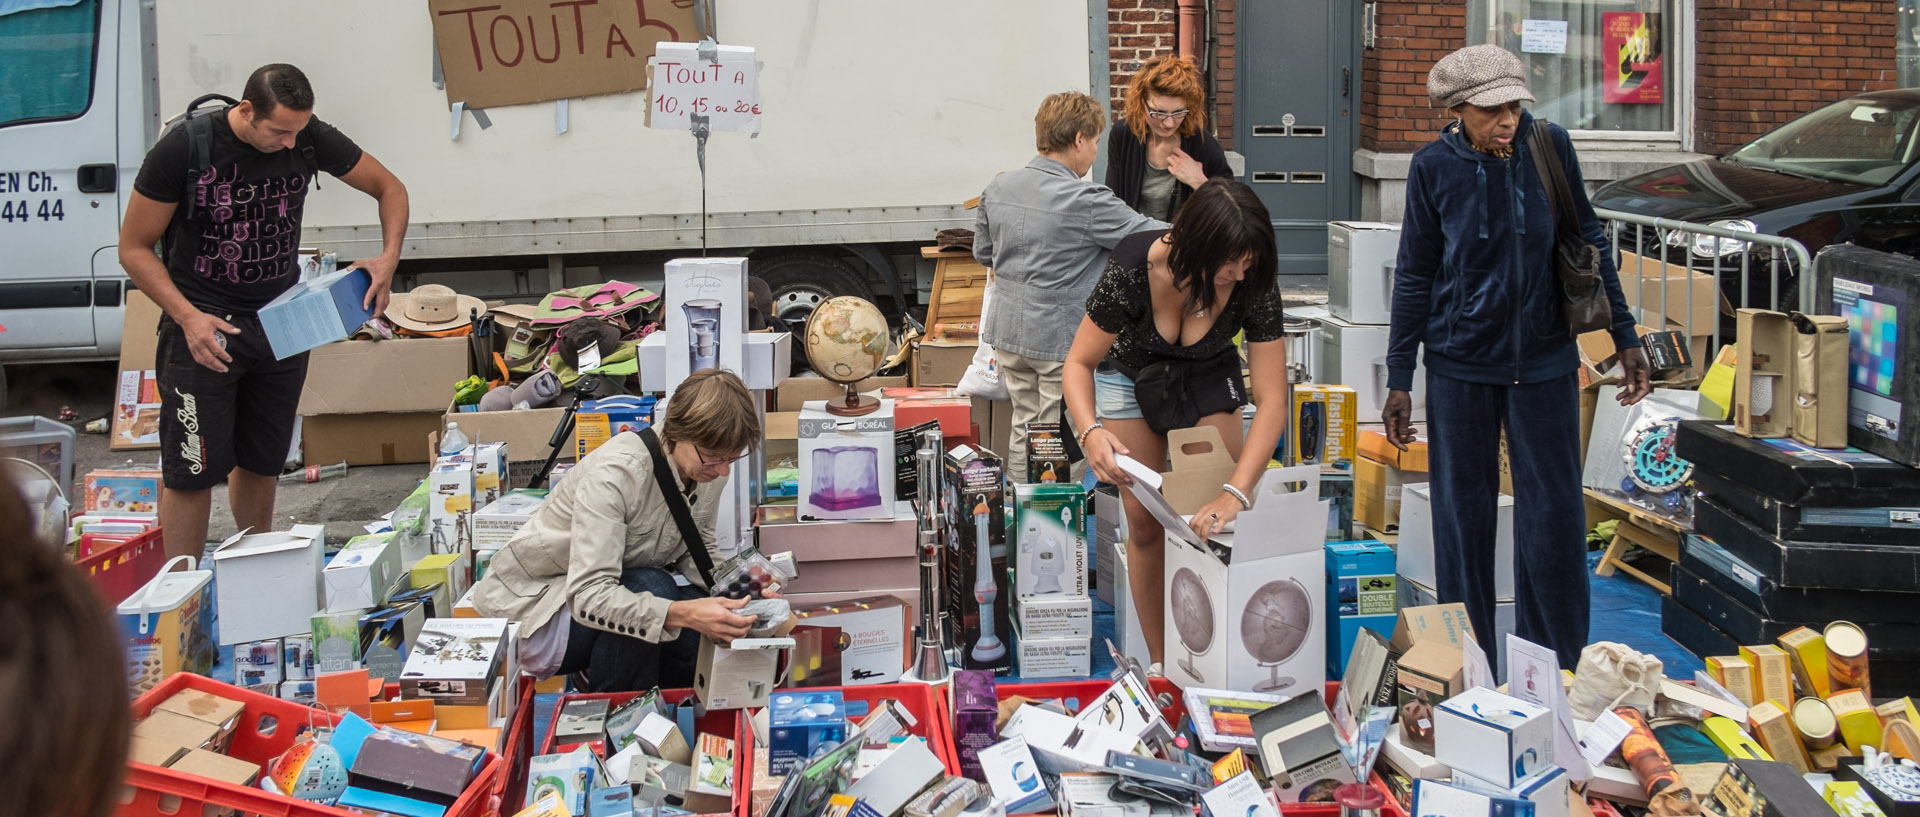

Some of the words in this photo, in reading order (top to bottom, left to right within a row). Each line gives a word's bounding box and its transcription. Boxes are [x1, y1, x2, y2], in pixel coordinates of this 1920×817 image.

[438, 0, 599, 72] TOUT
[606, 23, 636, 58] A
[658, 62, 723, 84] TOUT
[734, 70, 745, 85] A
[691, 97, 709, 113] 15
[715, 105, 728, 113] ou
[734, 99, 762, 115] 20€
[28, 171, 58, 192] Ch.
[1, 200, 29, 223] 44
[37, 198, 65, 222] 44
[1325, 392, 1345, 462] flashlight
[1075, 550, 1083, 596] ULTRA-VIOLET
[1362, 593, 1394, 602] DOUBLE
[1441, 610, 1458, 643] Chime
[235, 654, 275, 666] TRIPOD
[322, 656, 352, 671] titan
[1379, 684, 1392, 703] ZEN
